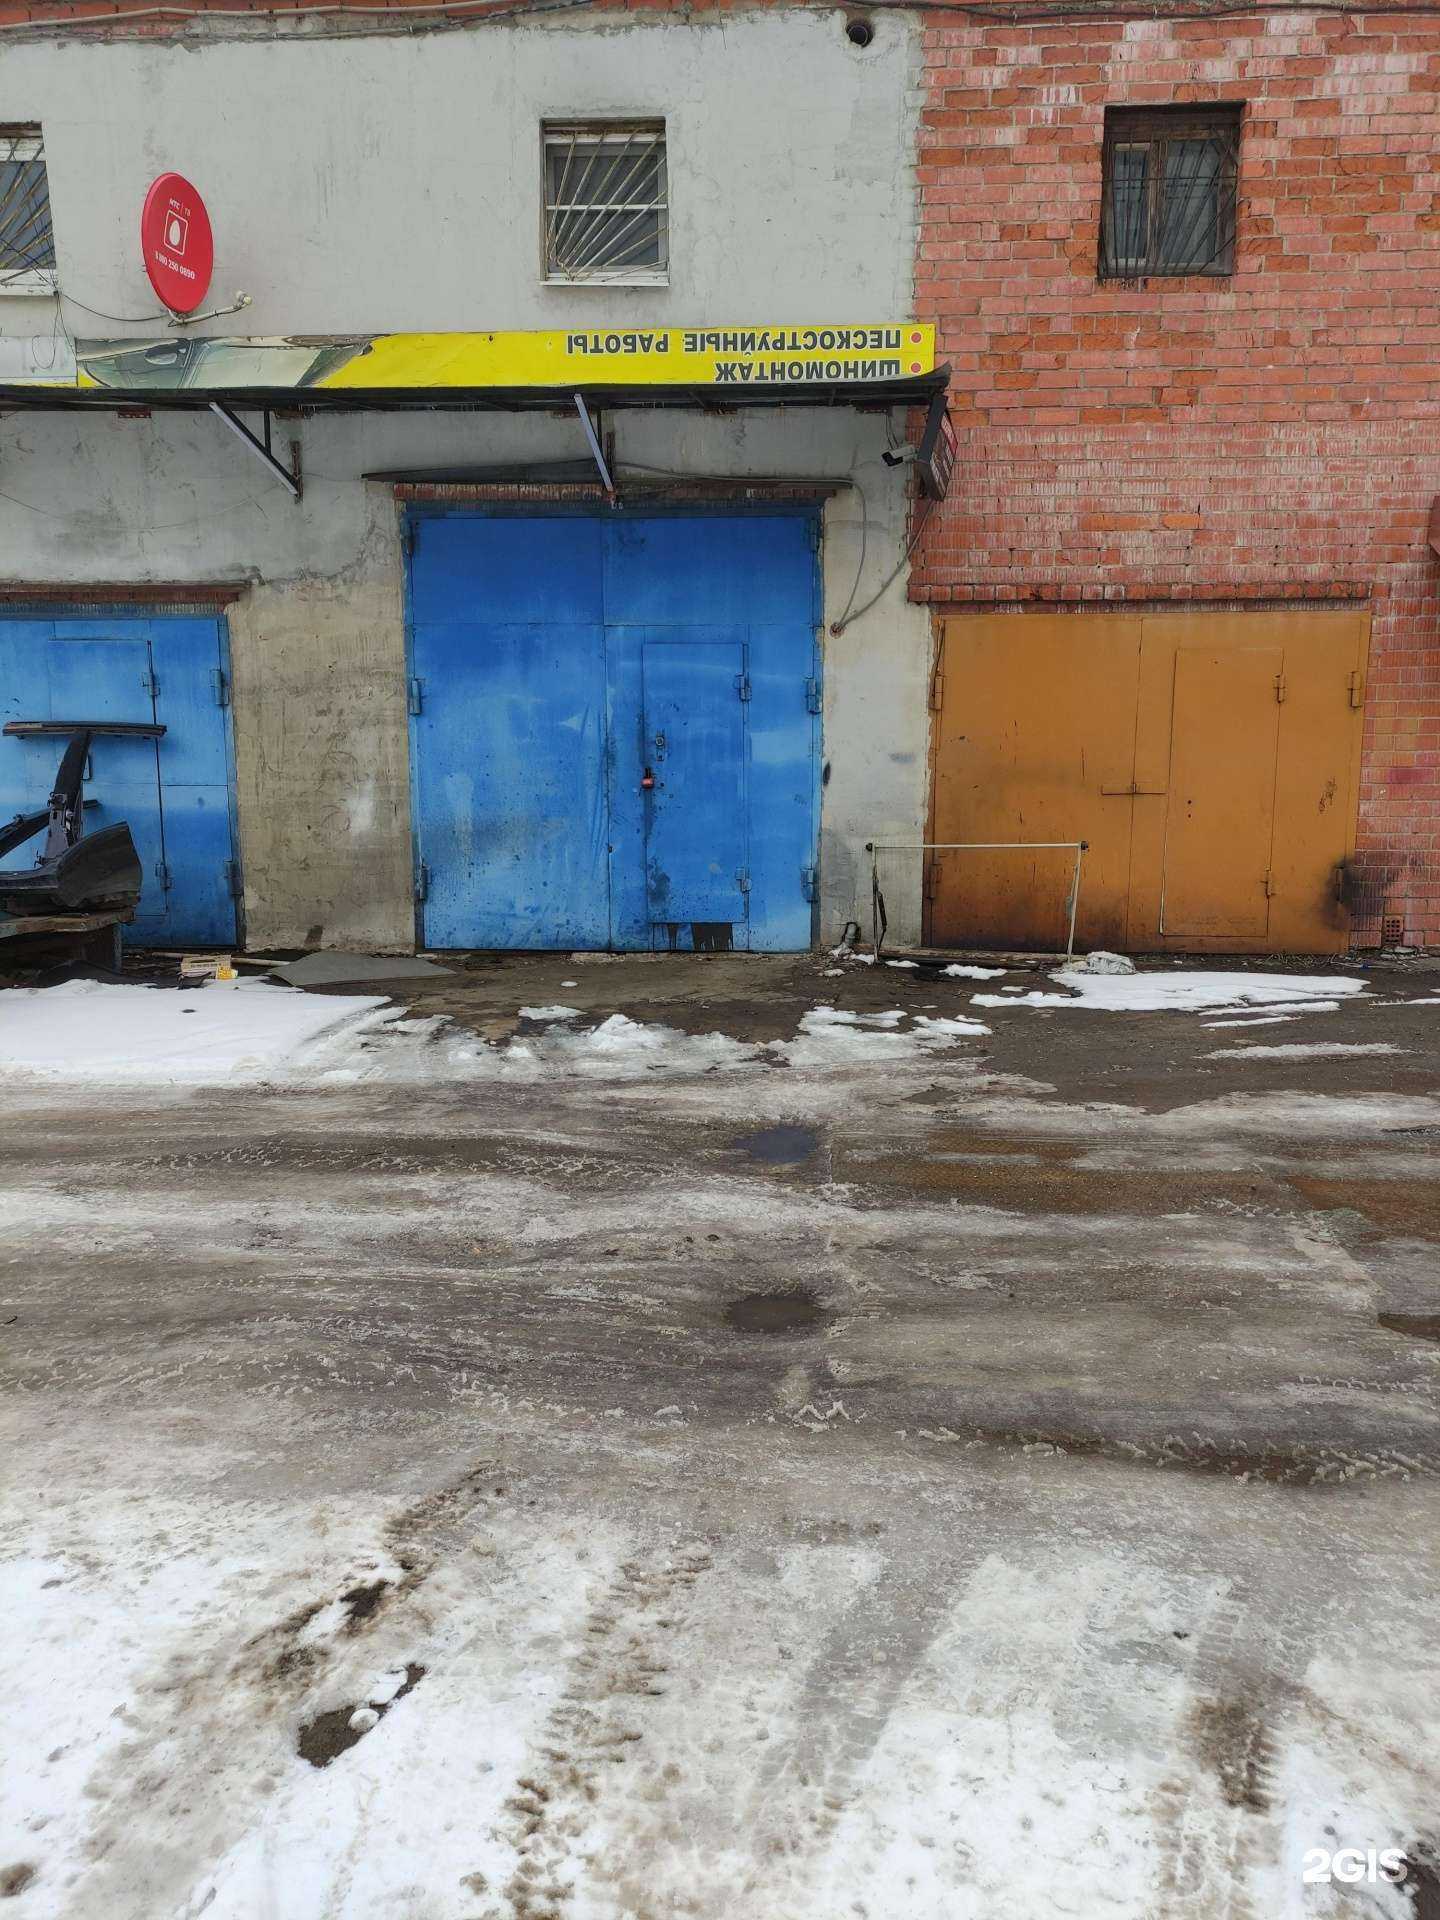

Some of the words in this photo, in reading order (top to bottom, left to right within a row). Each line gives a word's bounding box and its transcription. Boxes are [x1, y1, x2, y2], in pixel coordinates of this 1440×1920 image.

[168, 258, 179, 272] 250
[567, 332, 669, 354] РАБОТЫ
[684, 329, 901, 357] ПЕСКОСТРУЙНЫЕ
[715, 359, 901, 382] ШИНОМОНТАЖ
